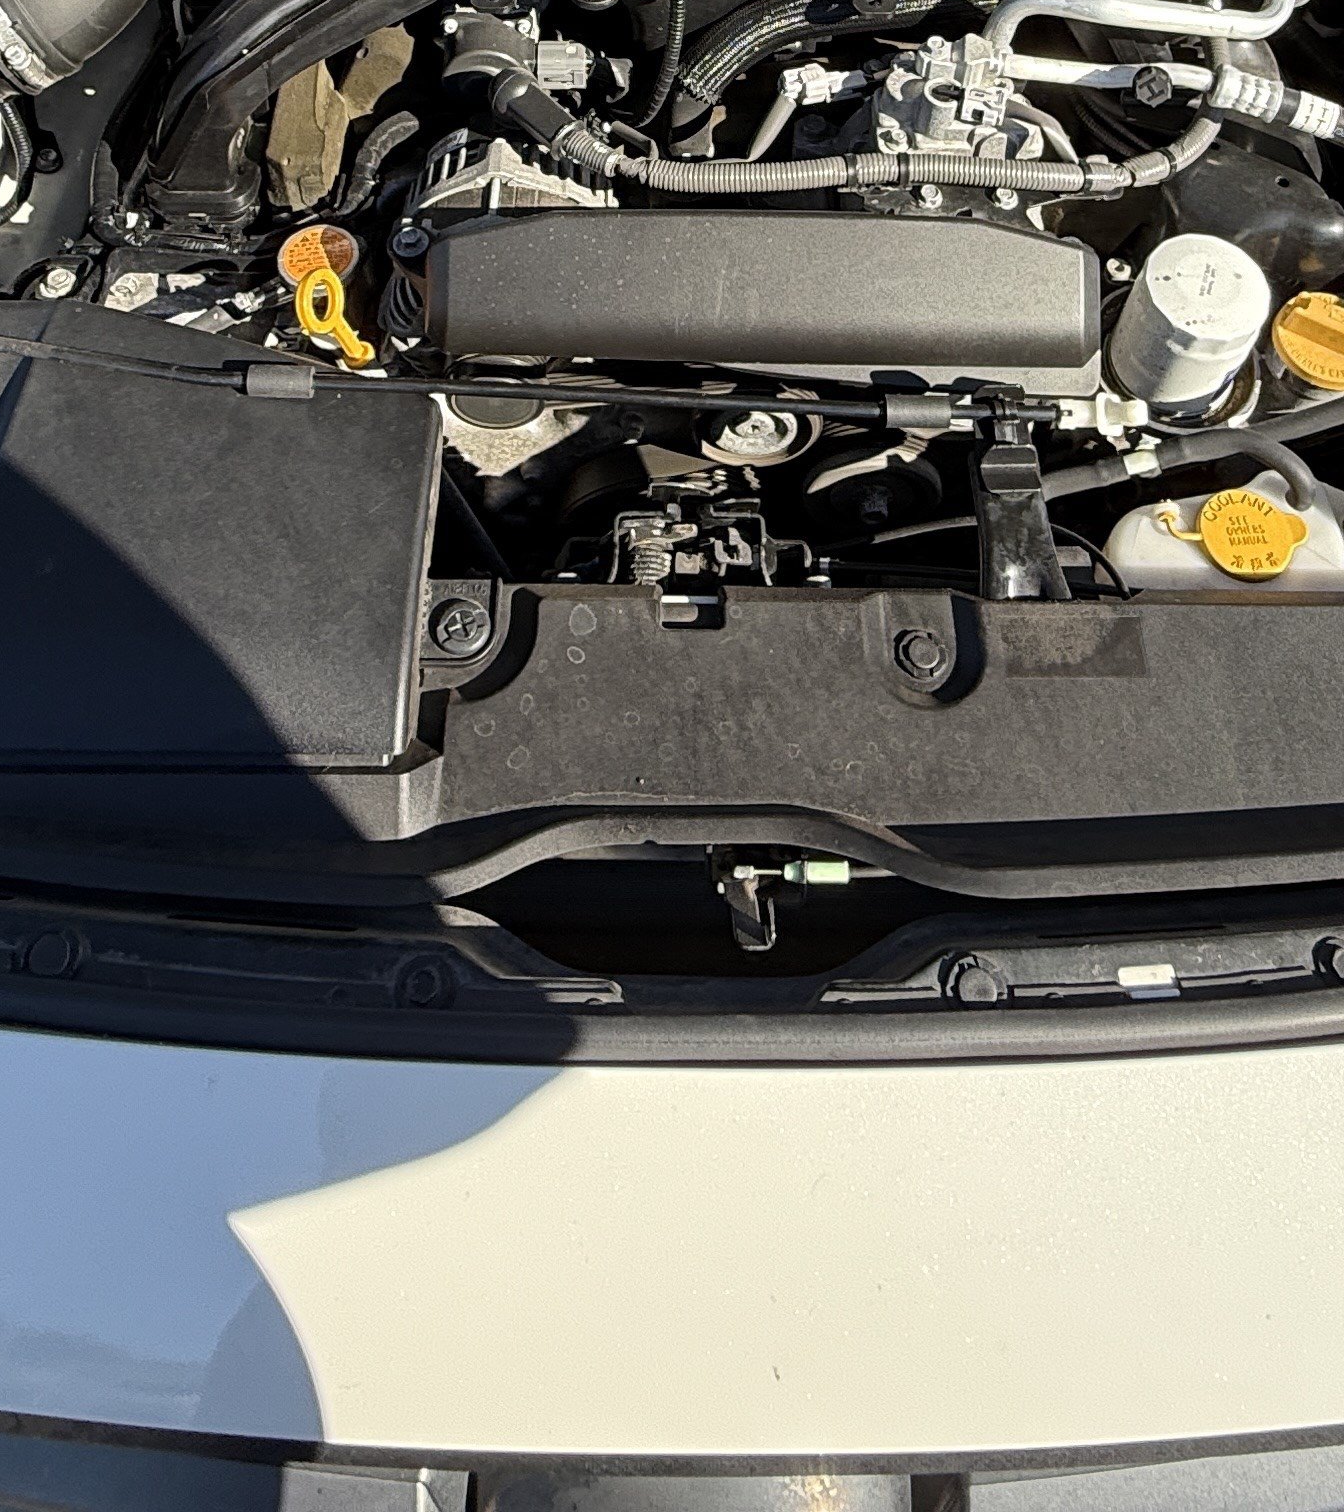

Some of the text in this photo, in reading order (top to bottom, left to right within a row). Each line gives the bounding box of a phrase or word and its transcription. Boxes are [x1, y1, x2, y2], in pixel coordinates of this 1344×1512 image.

[1203, 492, 1274, 522] COOLANT
[1228, 515, 1249, 525] SEE
[1229, 534, 1268, 546] MANUAL
